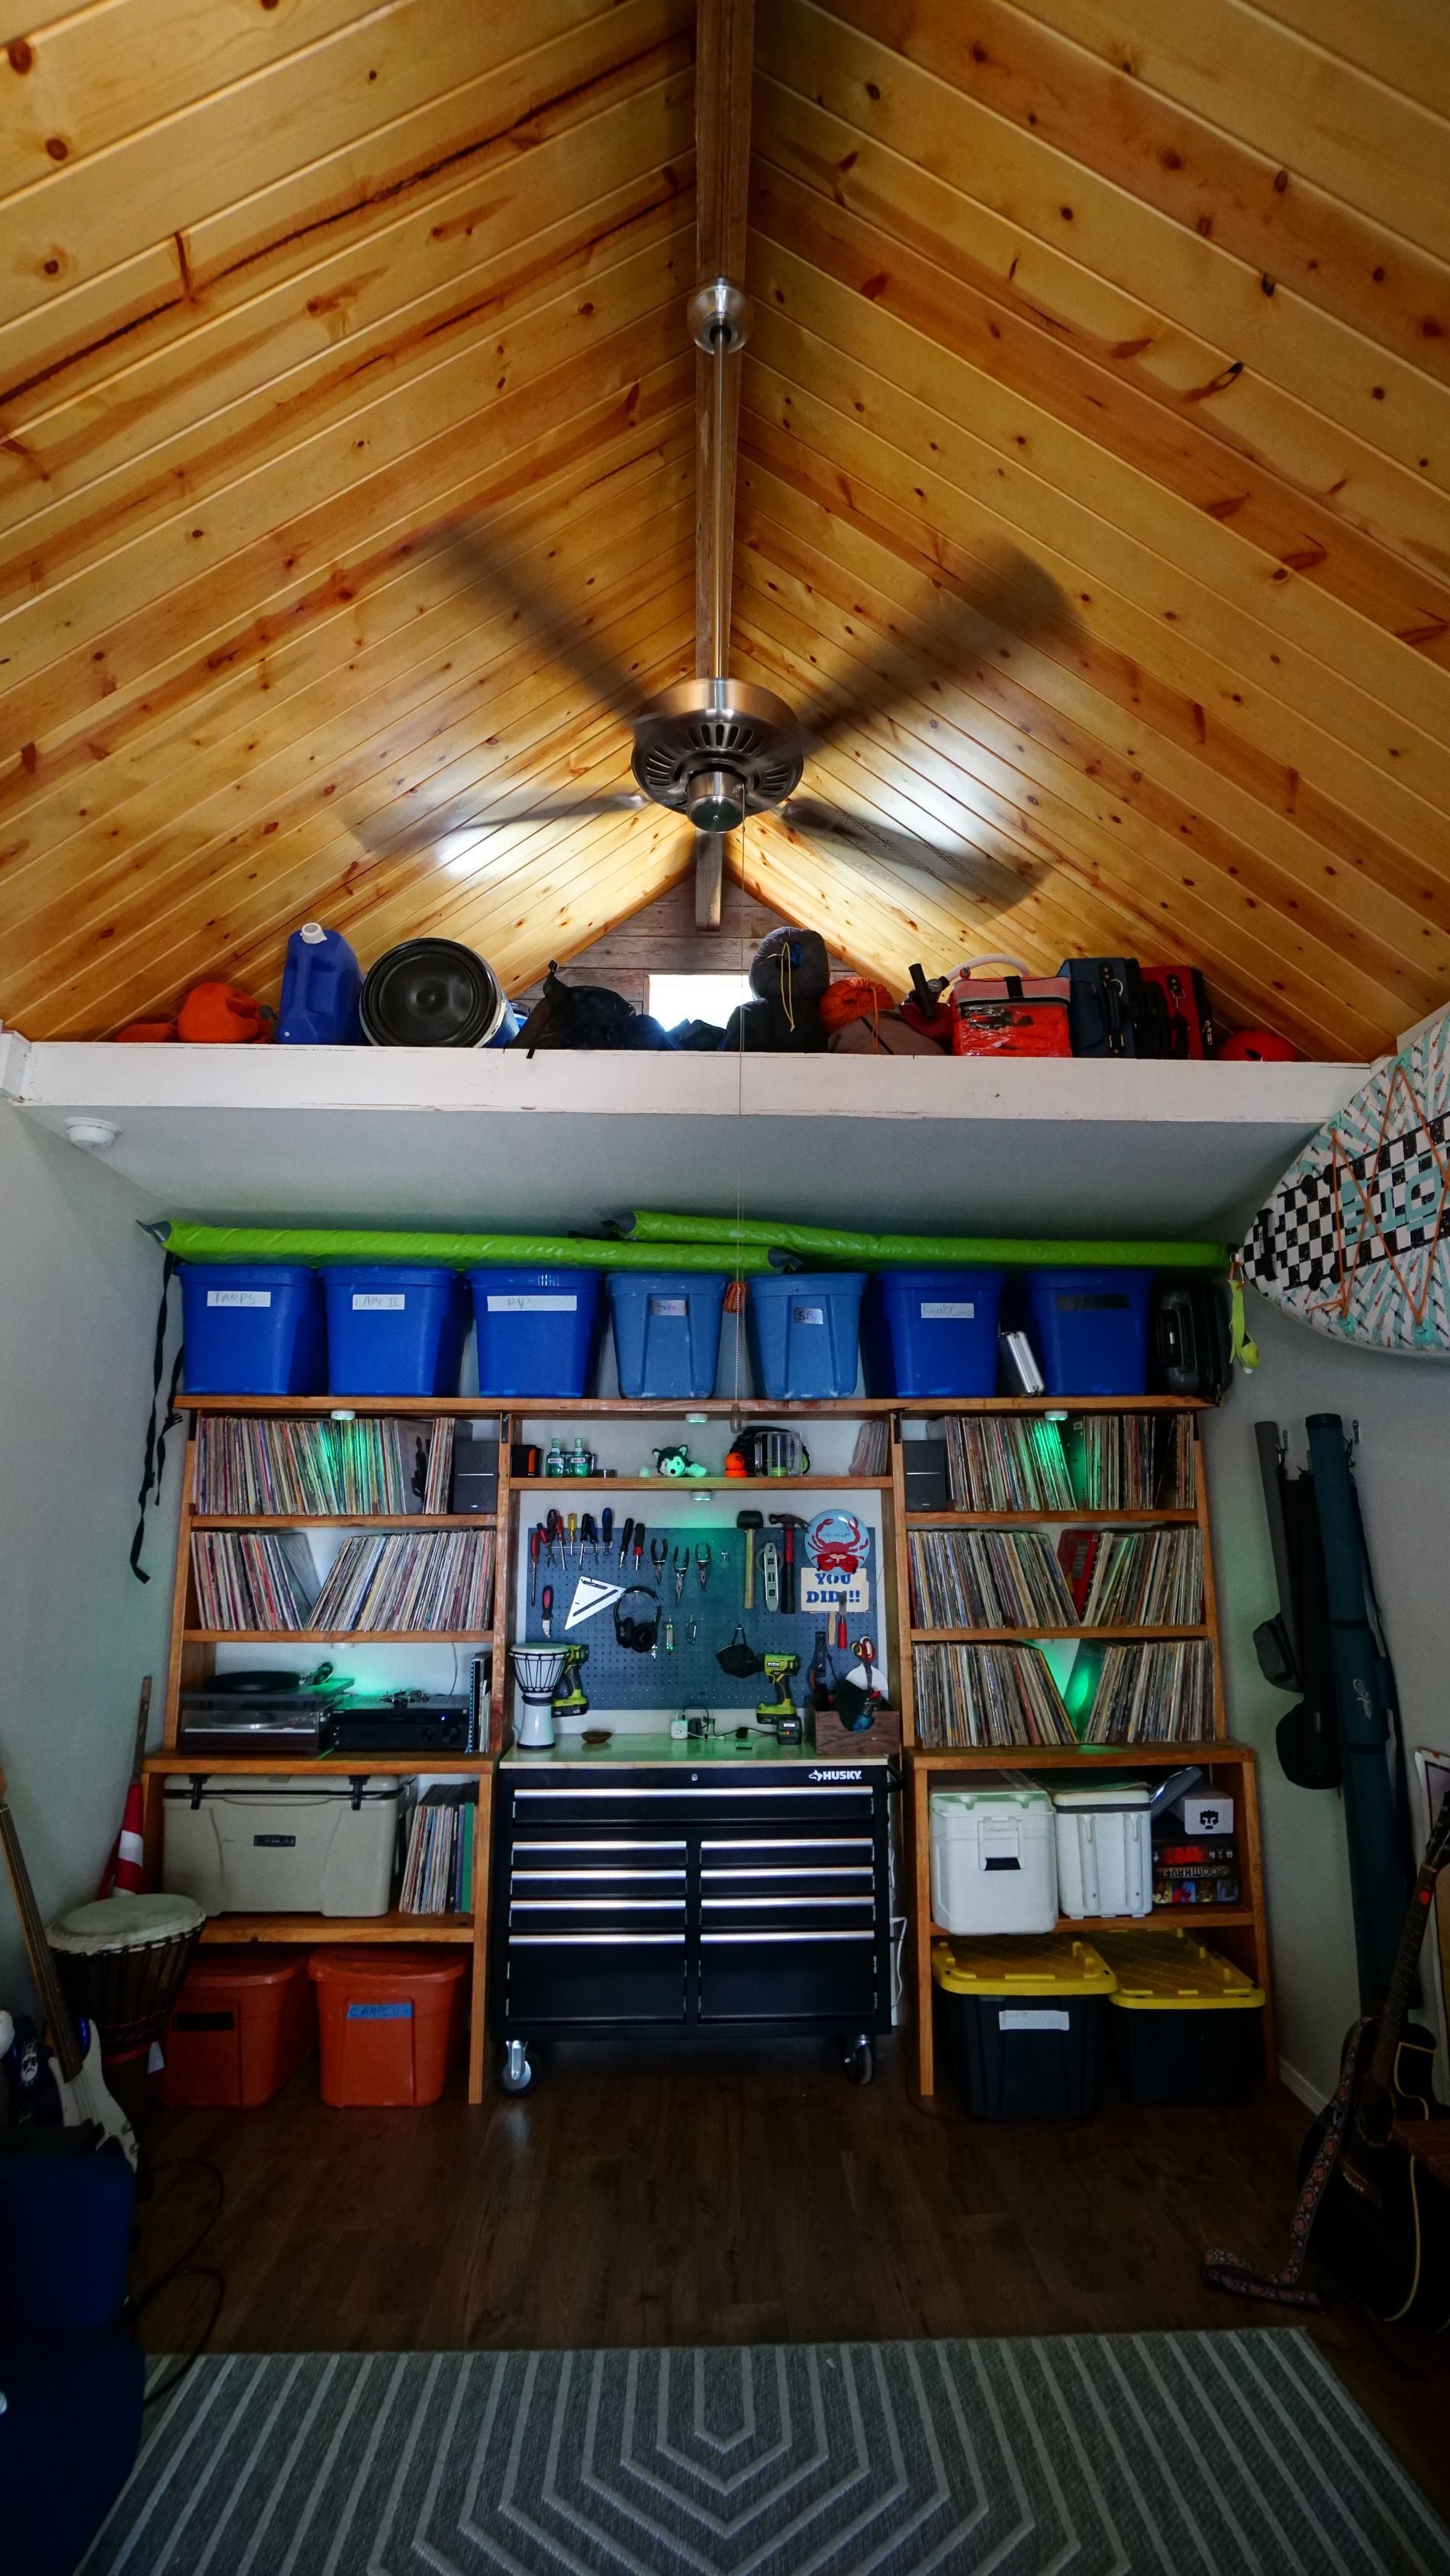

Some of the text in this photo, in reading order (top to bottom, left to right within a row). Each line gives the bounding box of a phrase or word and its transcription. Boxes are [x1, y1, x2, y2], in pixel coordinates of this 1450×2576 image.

[214, 1293, 256, 1306] TARPS
[815, 1573, 852, 1585] YOU
[807, 1590, 860, 1603] DID!!
[823, 1770, 862, 1780] HUSKY
